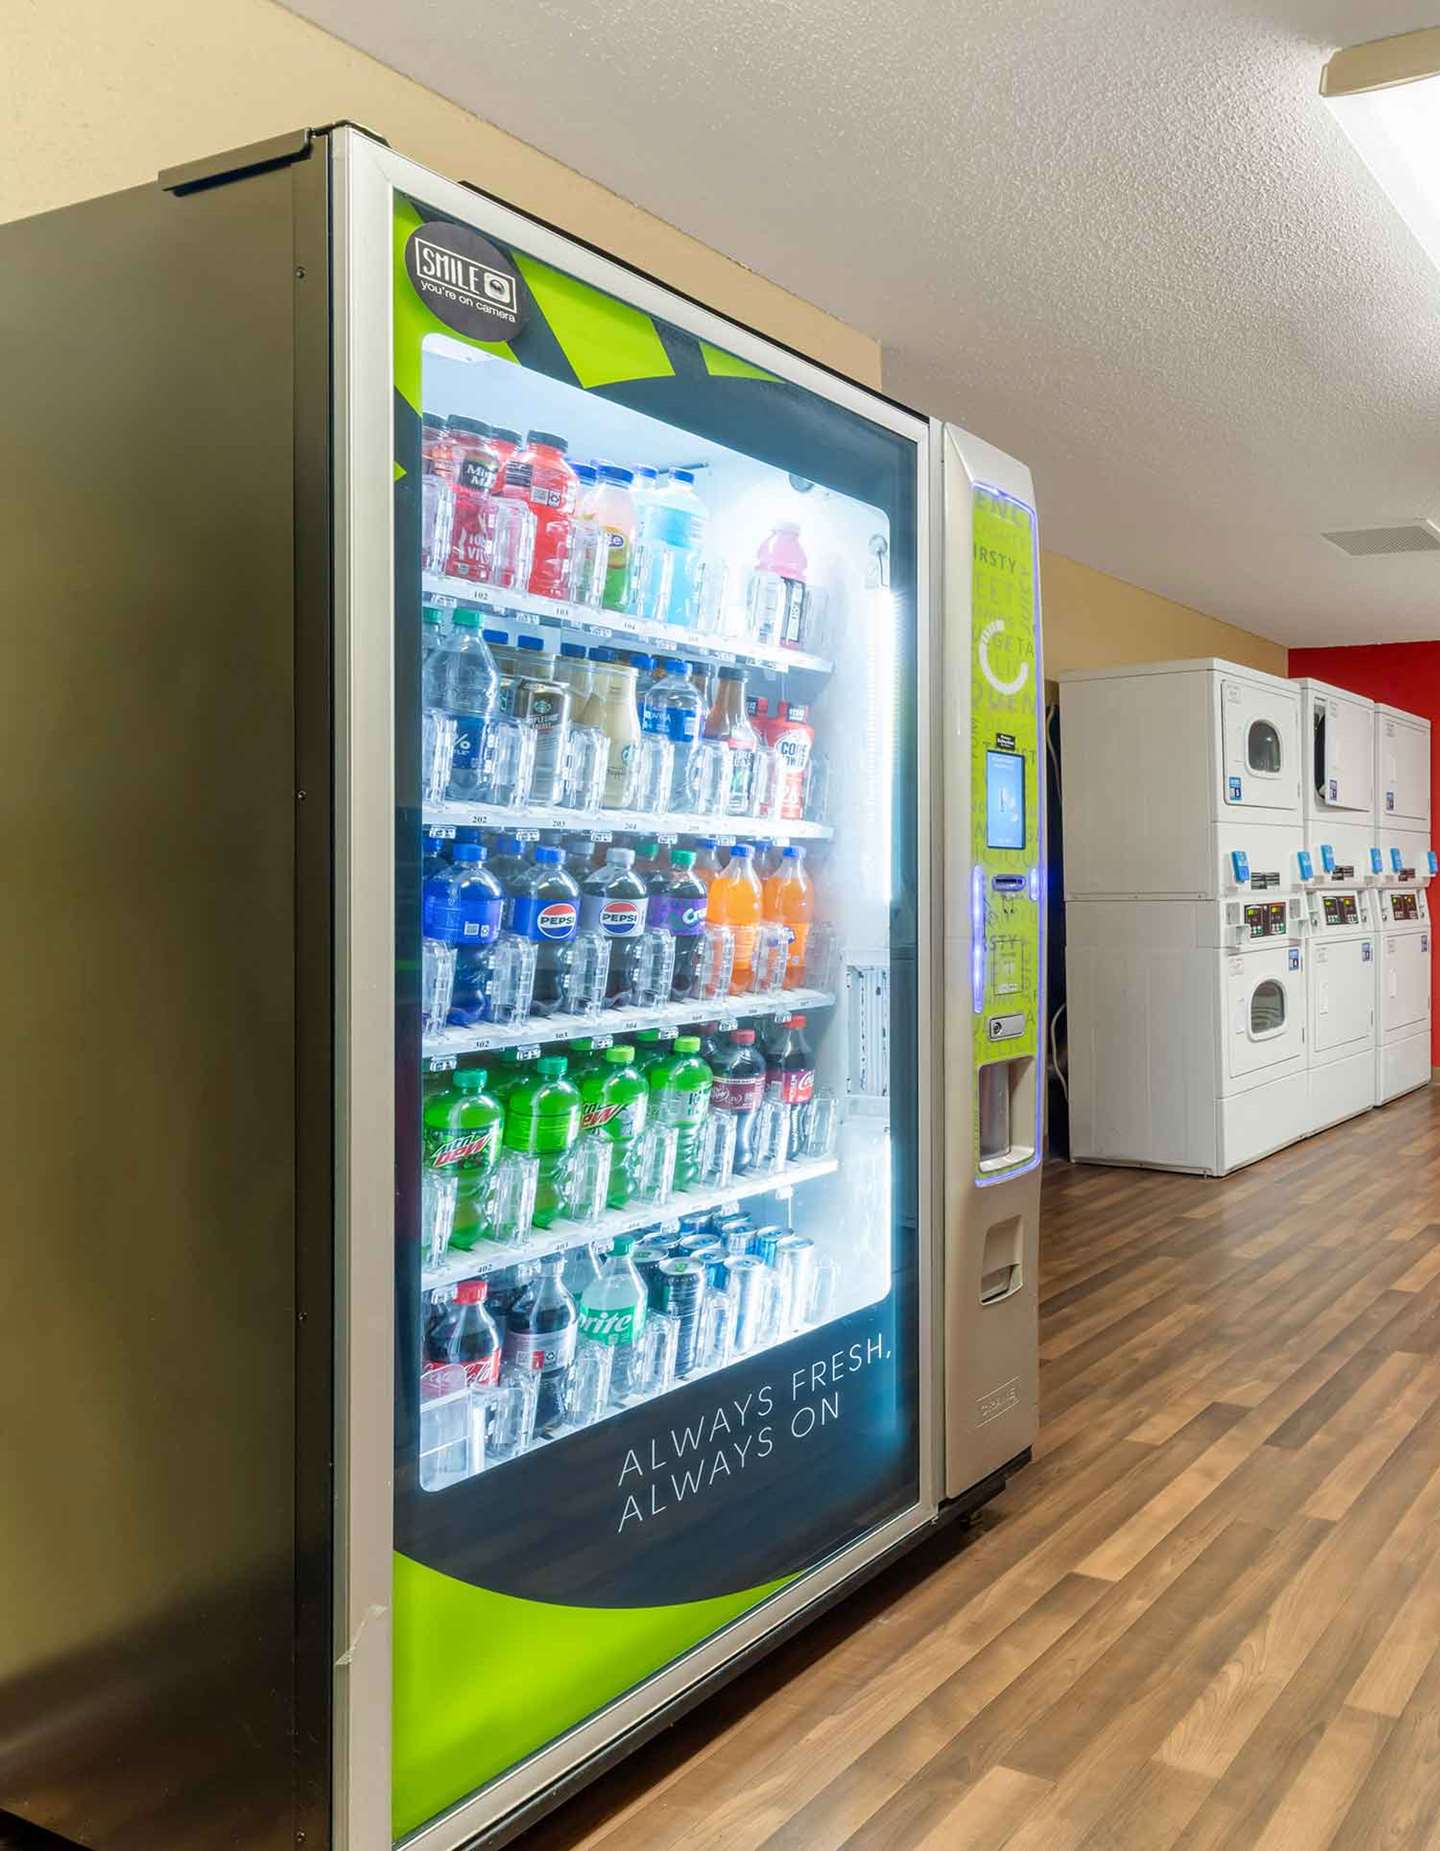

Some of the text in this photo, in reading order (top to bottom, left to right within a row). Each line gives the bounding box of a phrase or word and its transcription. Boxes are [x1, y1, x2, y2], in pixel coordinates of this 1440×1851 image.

[422, 247, 480, 295] SMILE
[420, 280, 516, 323] you're on camera
[472, 815, 488, 824] 202
[602, 913, 637, 922] PEPSI
[618, 1333, 893, 1487] ALWAYS FRESH,
[618, 1391, 839, 1533] ALWAYS ON
